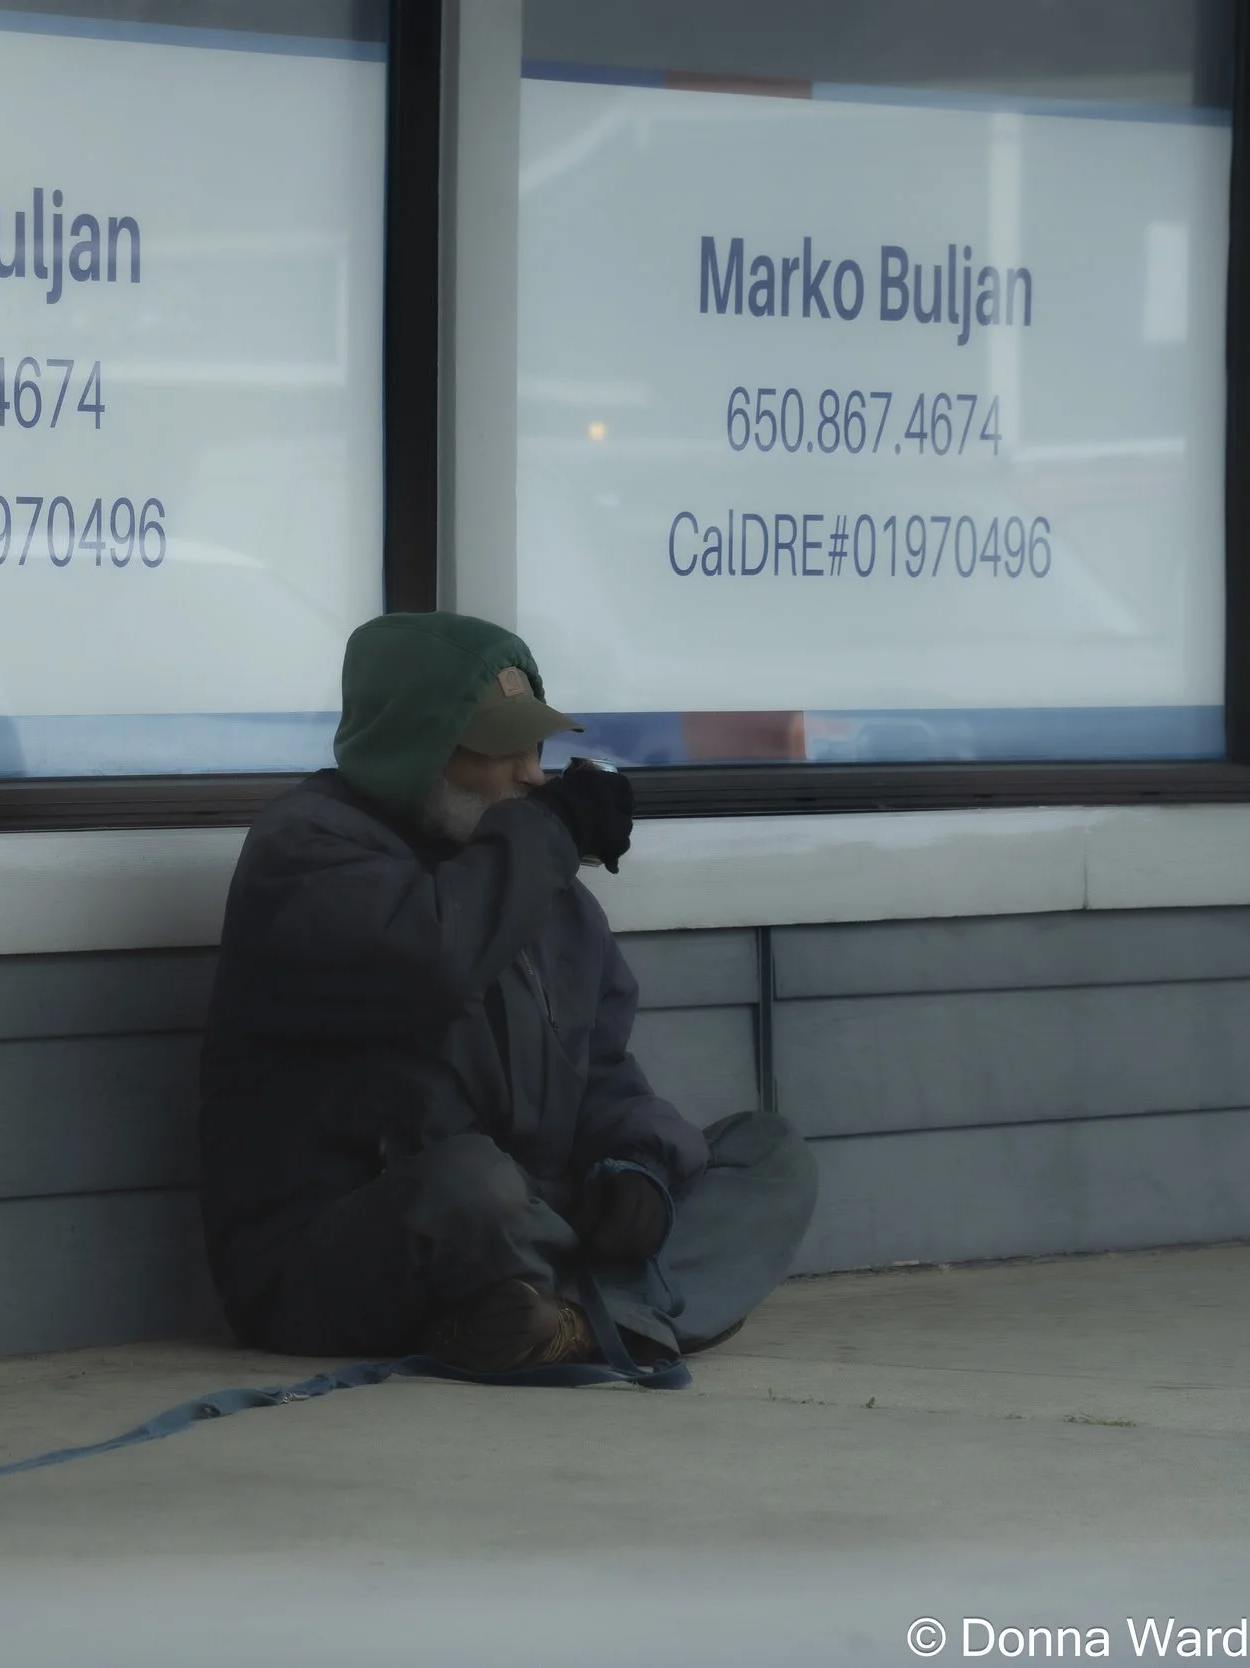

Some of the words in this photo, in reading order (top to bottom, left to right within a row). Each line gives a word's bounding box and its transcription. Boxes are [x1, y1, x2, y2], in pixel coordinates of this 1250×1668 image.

[698, 235, 865, 321] Marko
[879, 243, 1033, 347] Buljan
[726, 386, 1003, 456] 650.867.4674
[667, 508, 1052, 579] CalDRE#01970496
